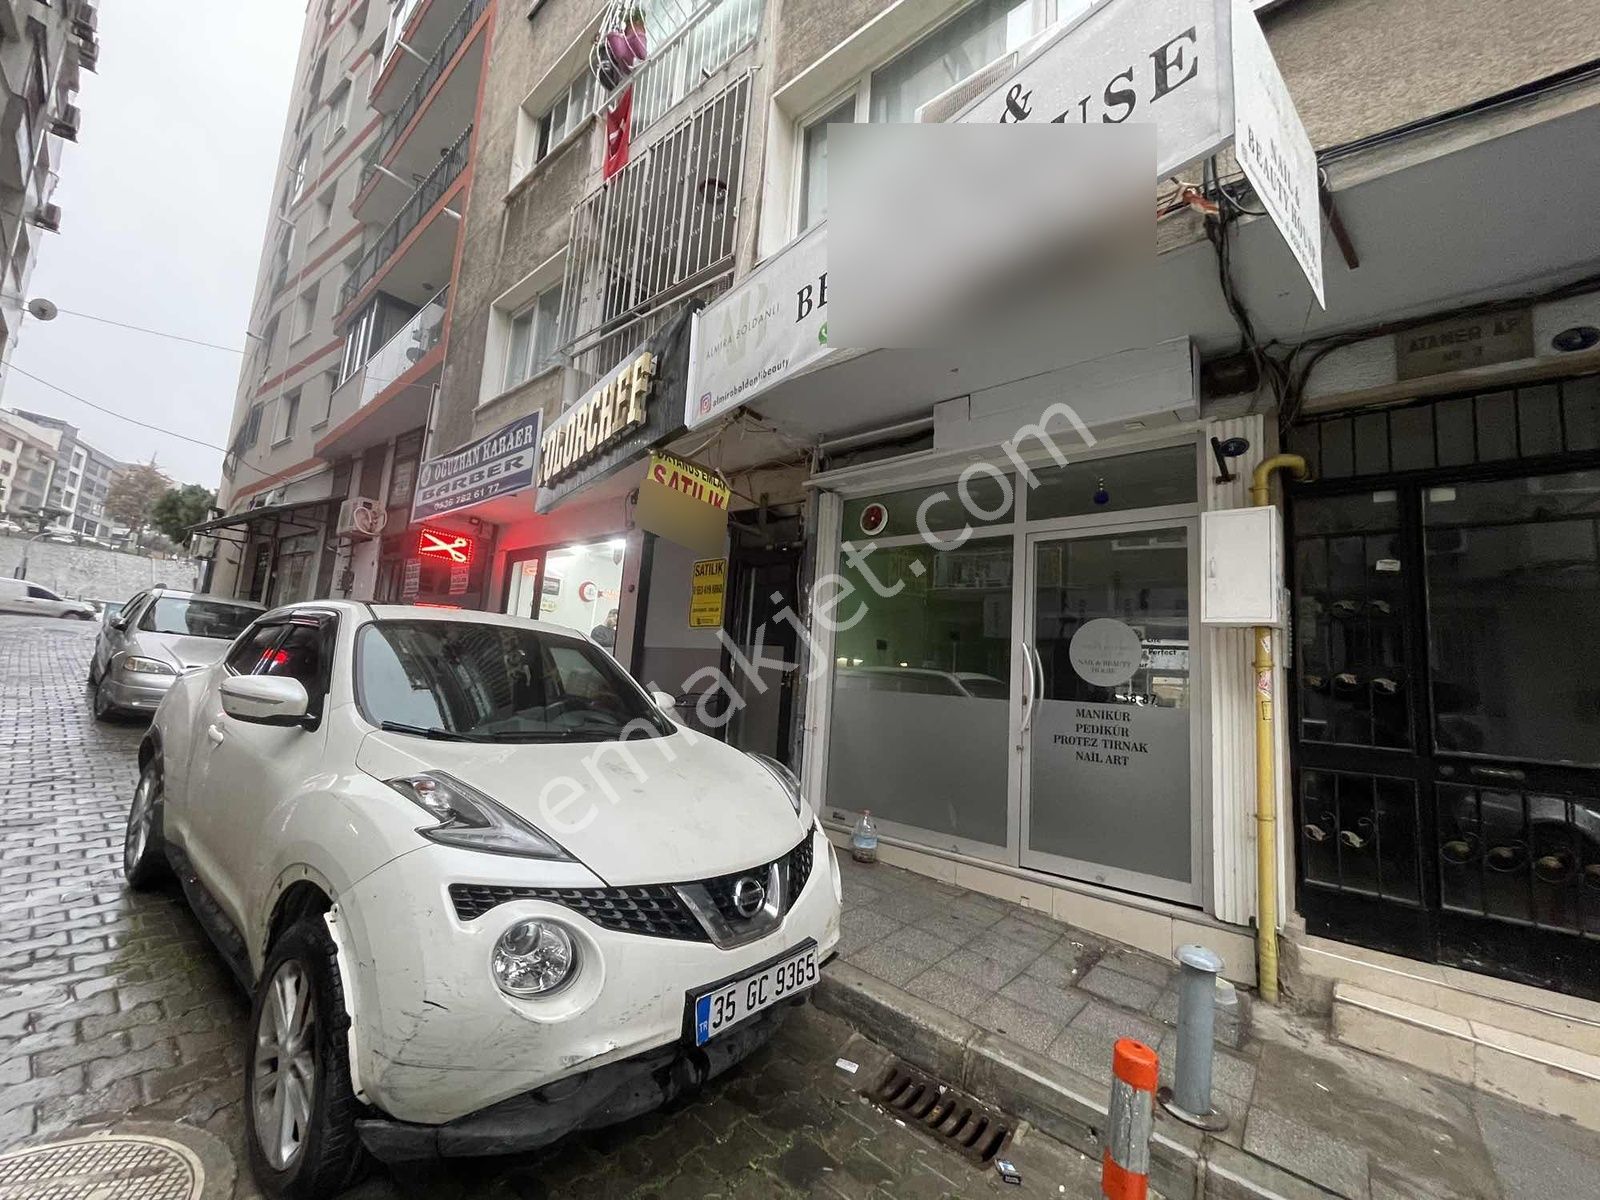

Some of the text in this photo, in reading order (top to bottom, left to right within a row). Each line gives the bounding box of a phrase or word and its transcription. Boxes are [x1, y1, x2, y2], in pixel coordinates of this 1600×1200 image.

[421, 455, 525, 500] BARBER
[695, 562, 723, 577] SATILIK
[1053, 734, 1149, 754] PROTEZ TIRNAK
[1104, 754, 1130, 766] ART
[712, 952, 815, 1029] 35 GC 9365
[698, 1022, 708, 1033] TR
